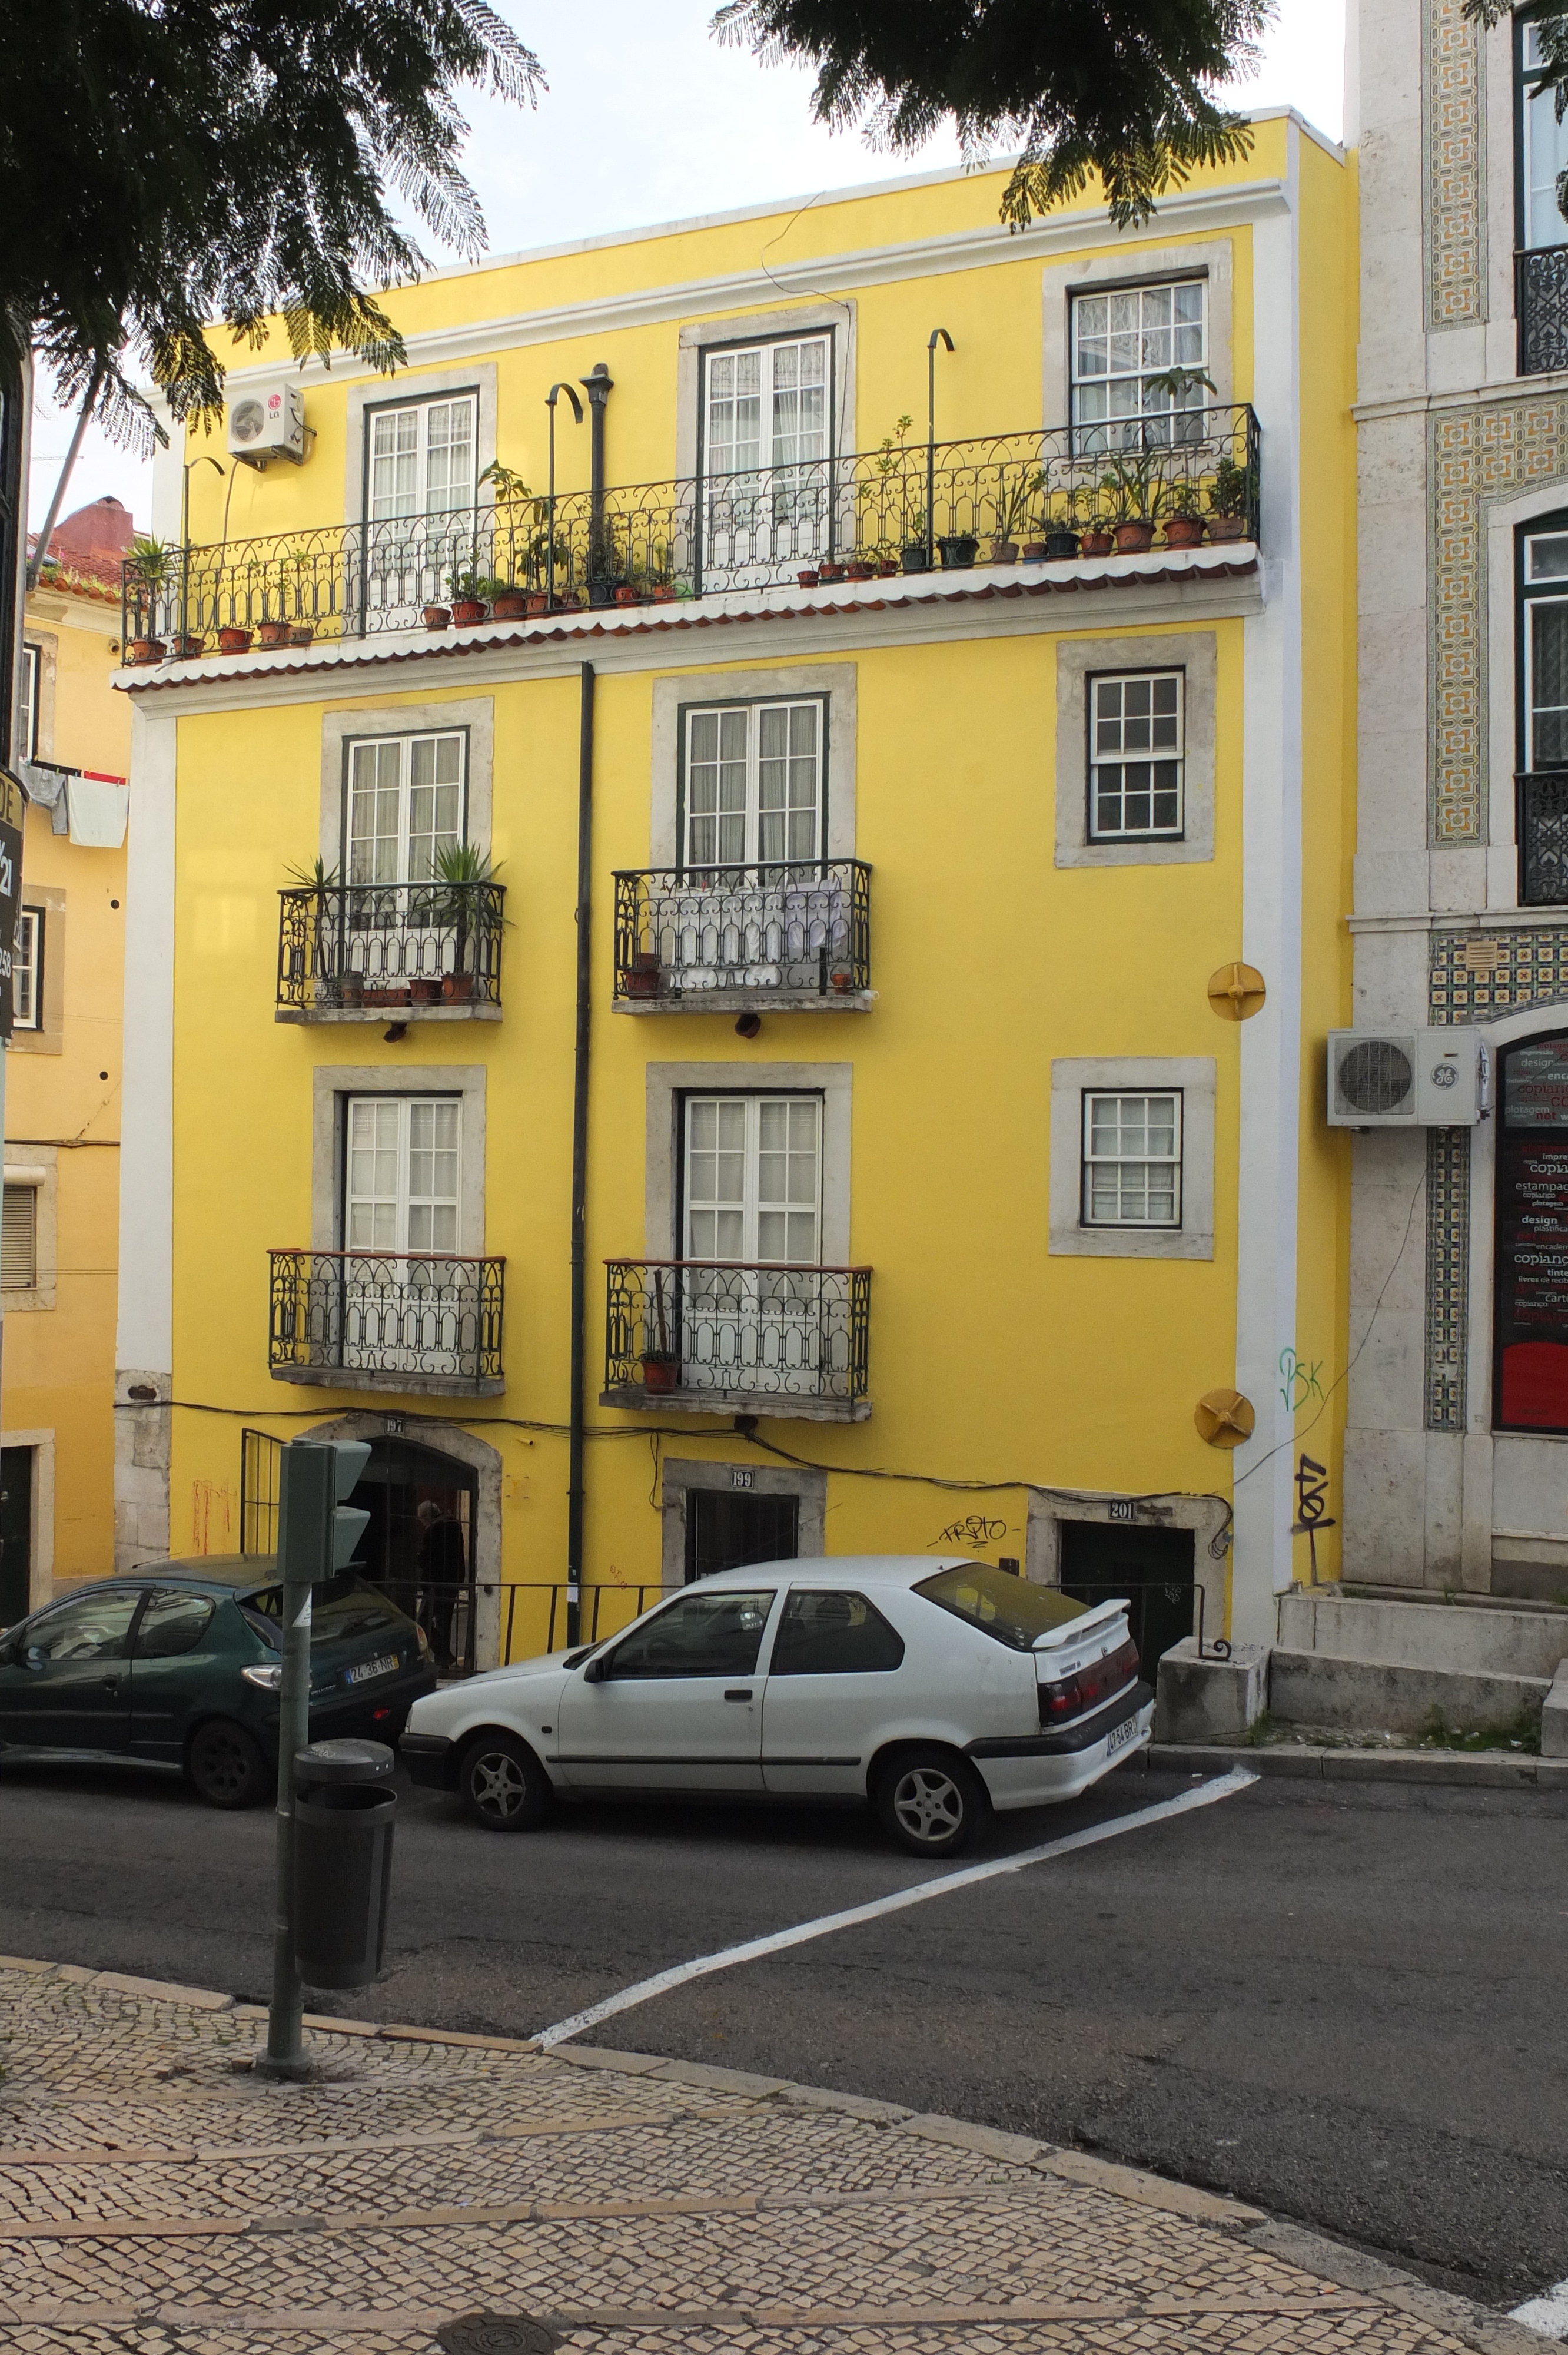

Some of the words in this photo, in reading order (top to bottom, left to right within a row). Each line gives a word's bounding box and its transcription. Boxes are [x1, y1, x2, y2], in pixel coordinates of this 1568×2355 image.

[269, 411, 280, 419] LG
[0, 947, 11, 979] 58
[1522, 1215, 1558, 1226] design
[387, 1419, 402, 1432] 197
[733, 1472, 751, 1487] 199
[1111, 1502, 1132, 1518] 201
